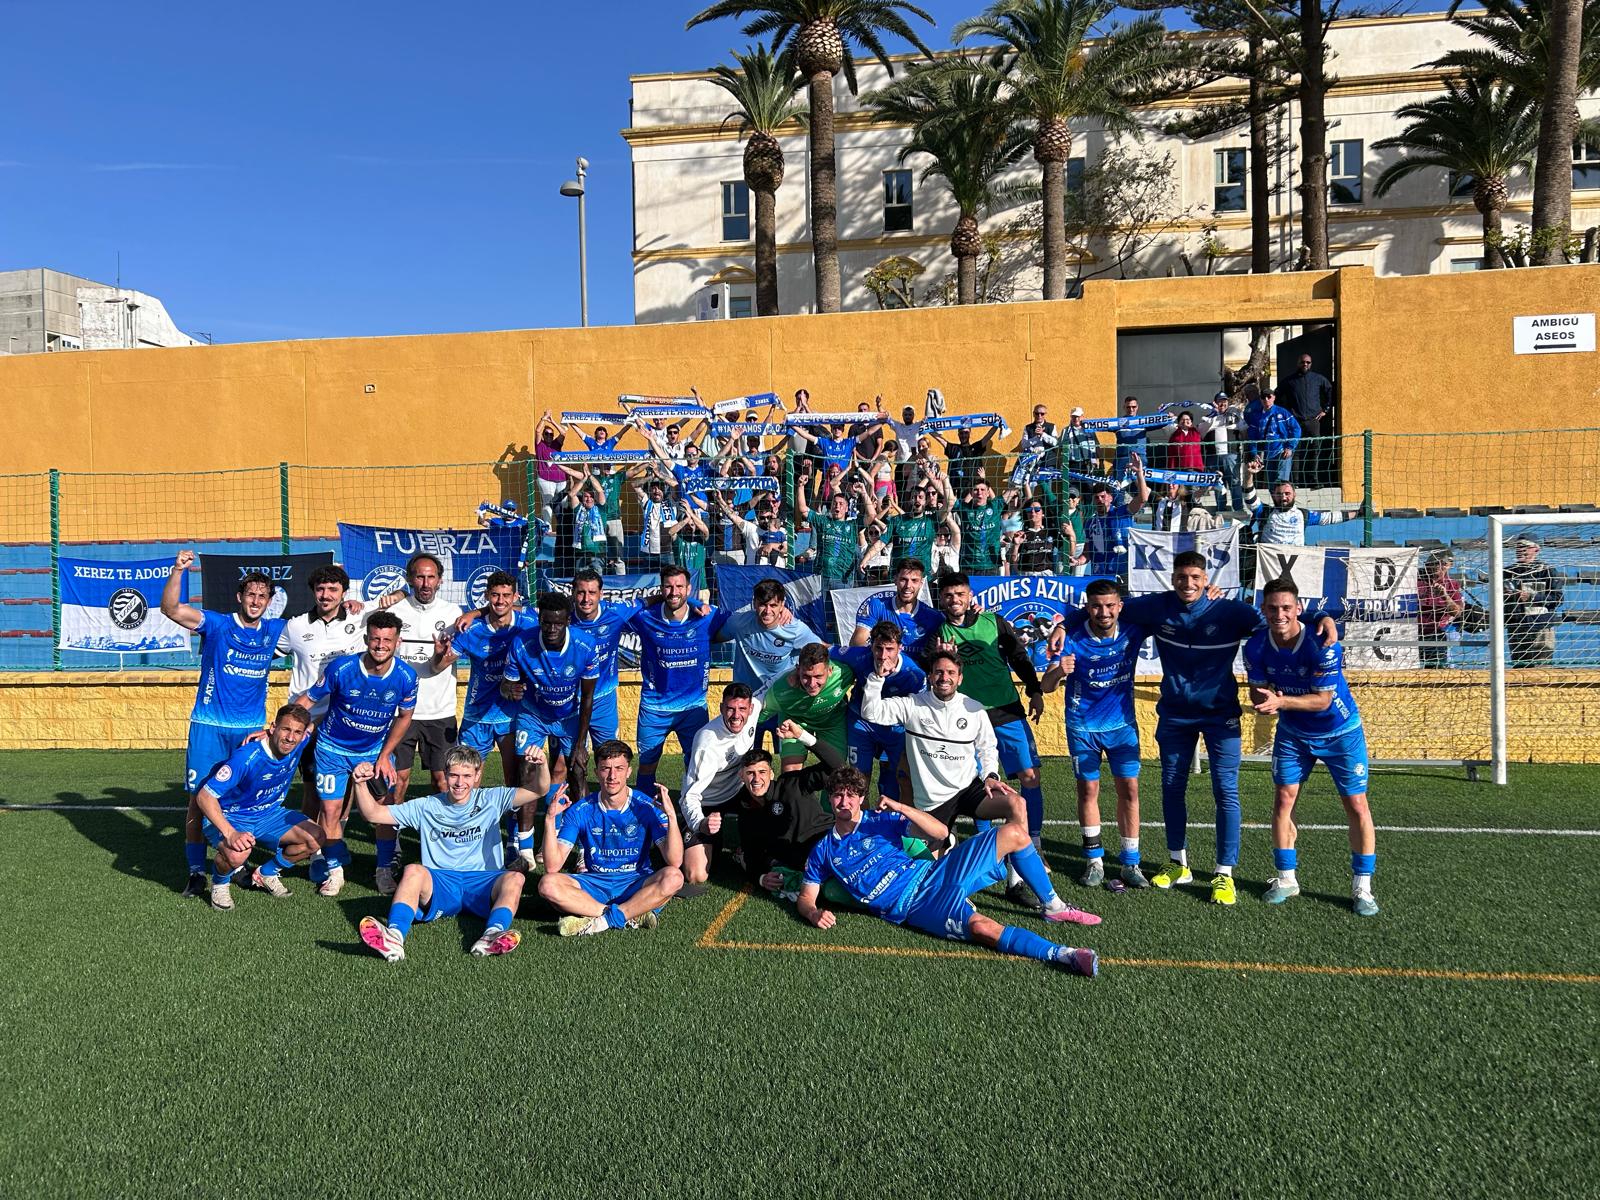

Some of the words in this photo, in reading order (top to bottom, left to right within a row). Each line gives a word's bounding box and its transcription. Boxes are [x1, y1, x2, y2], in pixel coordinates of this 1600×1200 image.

[1535, 331, 1575, 340] ASEOS
[638, 408, 664, 416] XEREZ
[665, 408, 676, 416] TE
[677, 406, 707, 416] ADOBO
[609, 453, 641, 461] ADOBO
[374, 530, 498, 556] FUERZA
[1132, 543, 1167, 571] K
[74, 565, 115, 580] XEREZ
[116, 568, 132, 580] TE
[1373, 557, 1396, 592] D
[663, 645, 698, 655] HIPOTELS
[1373, 627, 1392, 661] C
[352, 707, 393, 719] HIPOTELS
[316, 773, 336, 794] 20
[441, 825, 481, 838] VILOITA
[598, 847, 639, 857] HIPOTELS
